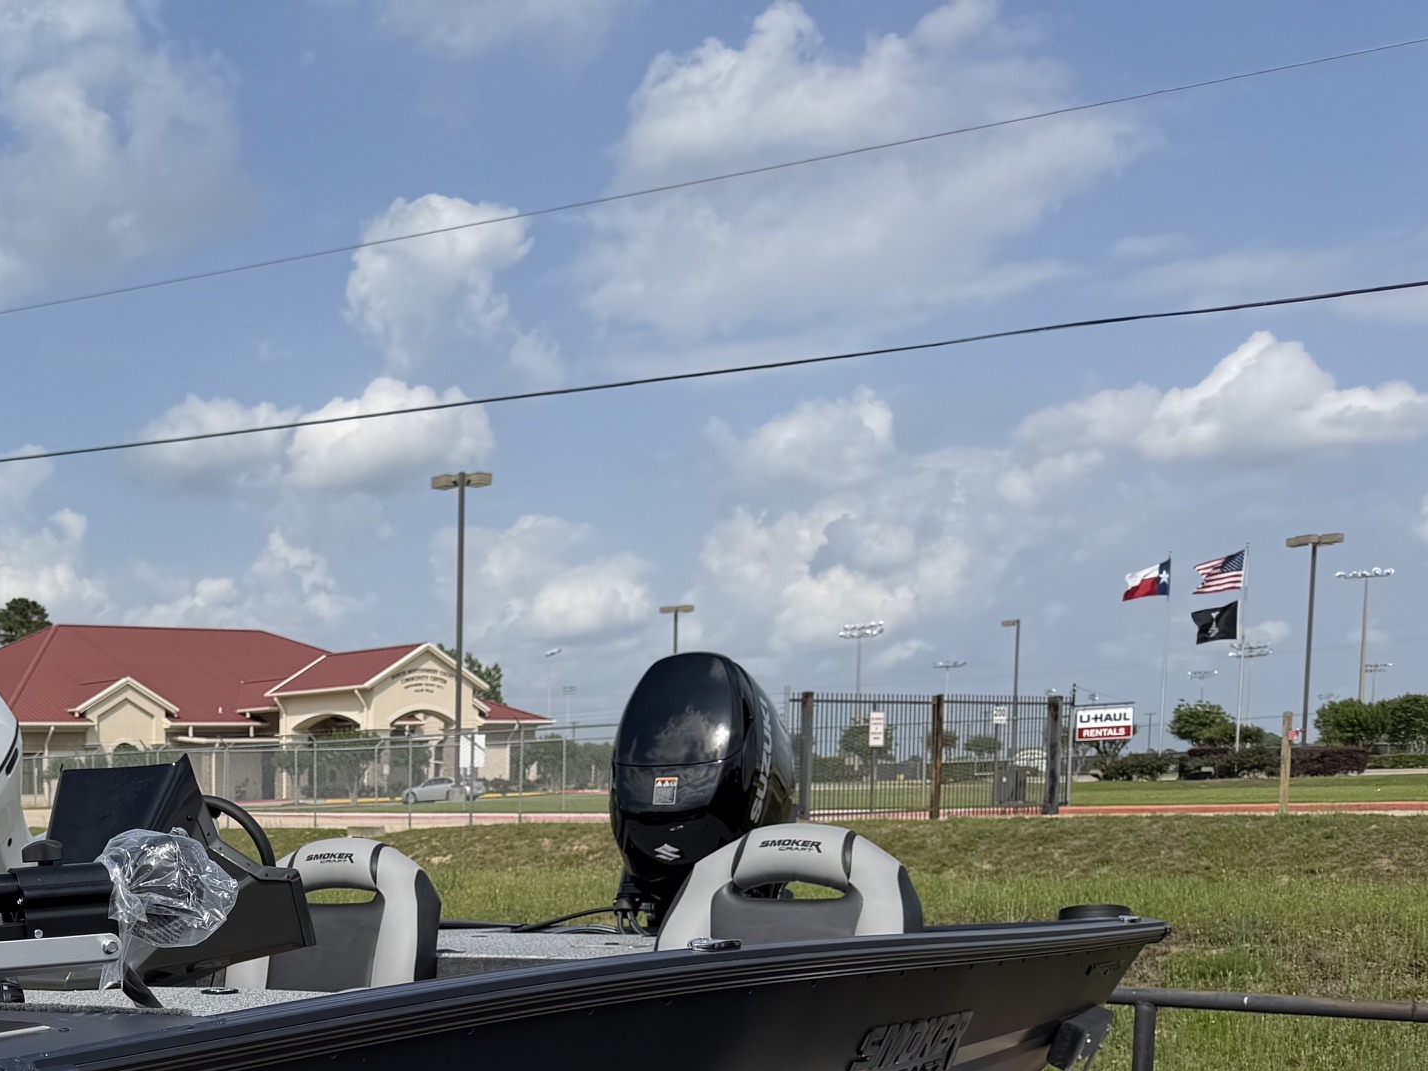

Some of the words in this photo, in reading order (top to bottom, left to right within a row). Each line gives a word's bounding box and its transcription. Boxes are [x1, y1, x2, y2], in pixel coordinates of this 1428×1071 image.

[1079, 713, 1130, 724] U-HAUL
[1082, 727, 1126, 738] RENTALS
[759, 839, 822, 853] SMOKER
[305, 852, 354, 864] SMOKER
